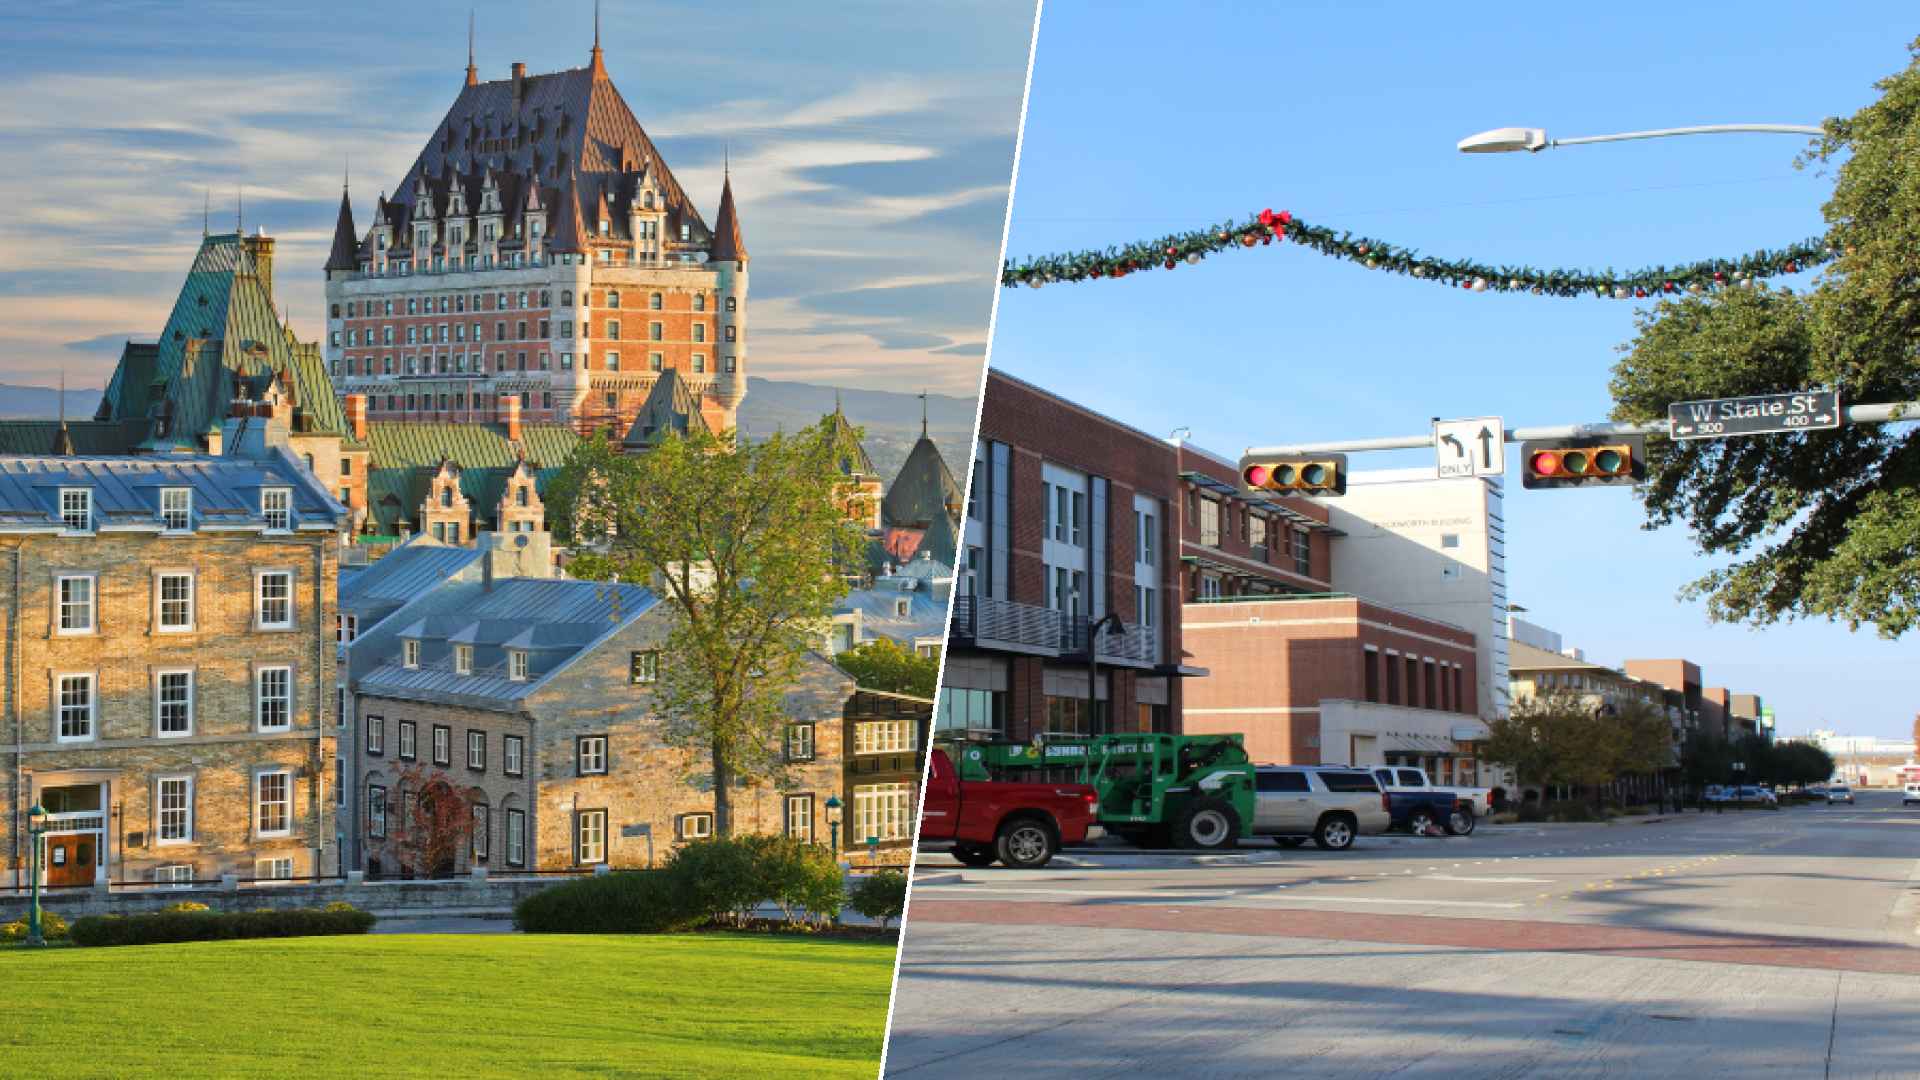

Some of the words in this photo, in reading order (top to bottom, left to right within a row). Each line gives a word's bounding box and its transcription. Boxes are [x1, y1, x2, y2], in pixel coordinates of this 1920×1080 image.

[1690, 404, 1712, 422] W
[1720, 402, 1782, 420] State
[1792, 396, 1817, 415] St
[1784, 416, 1809, 426] 400
[1441, 464, 1471, 474] ONLY
